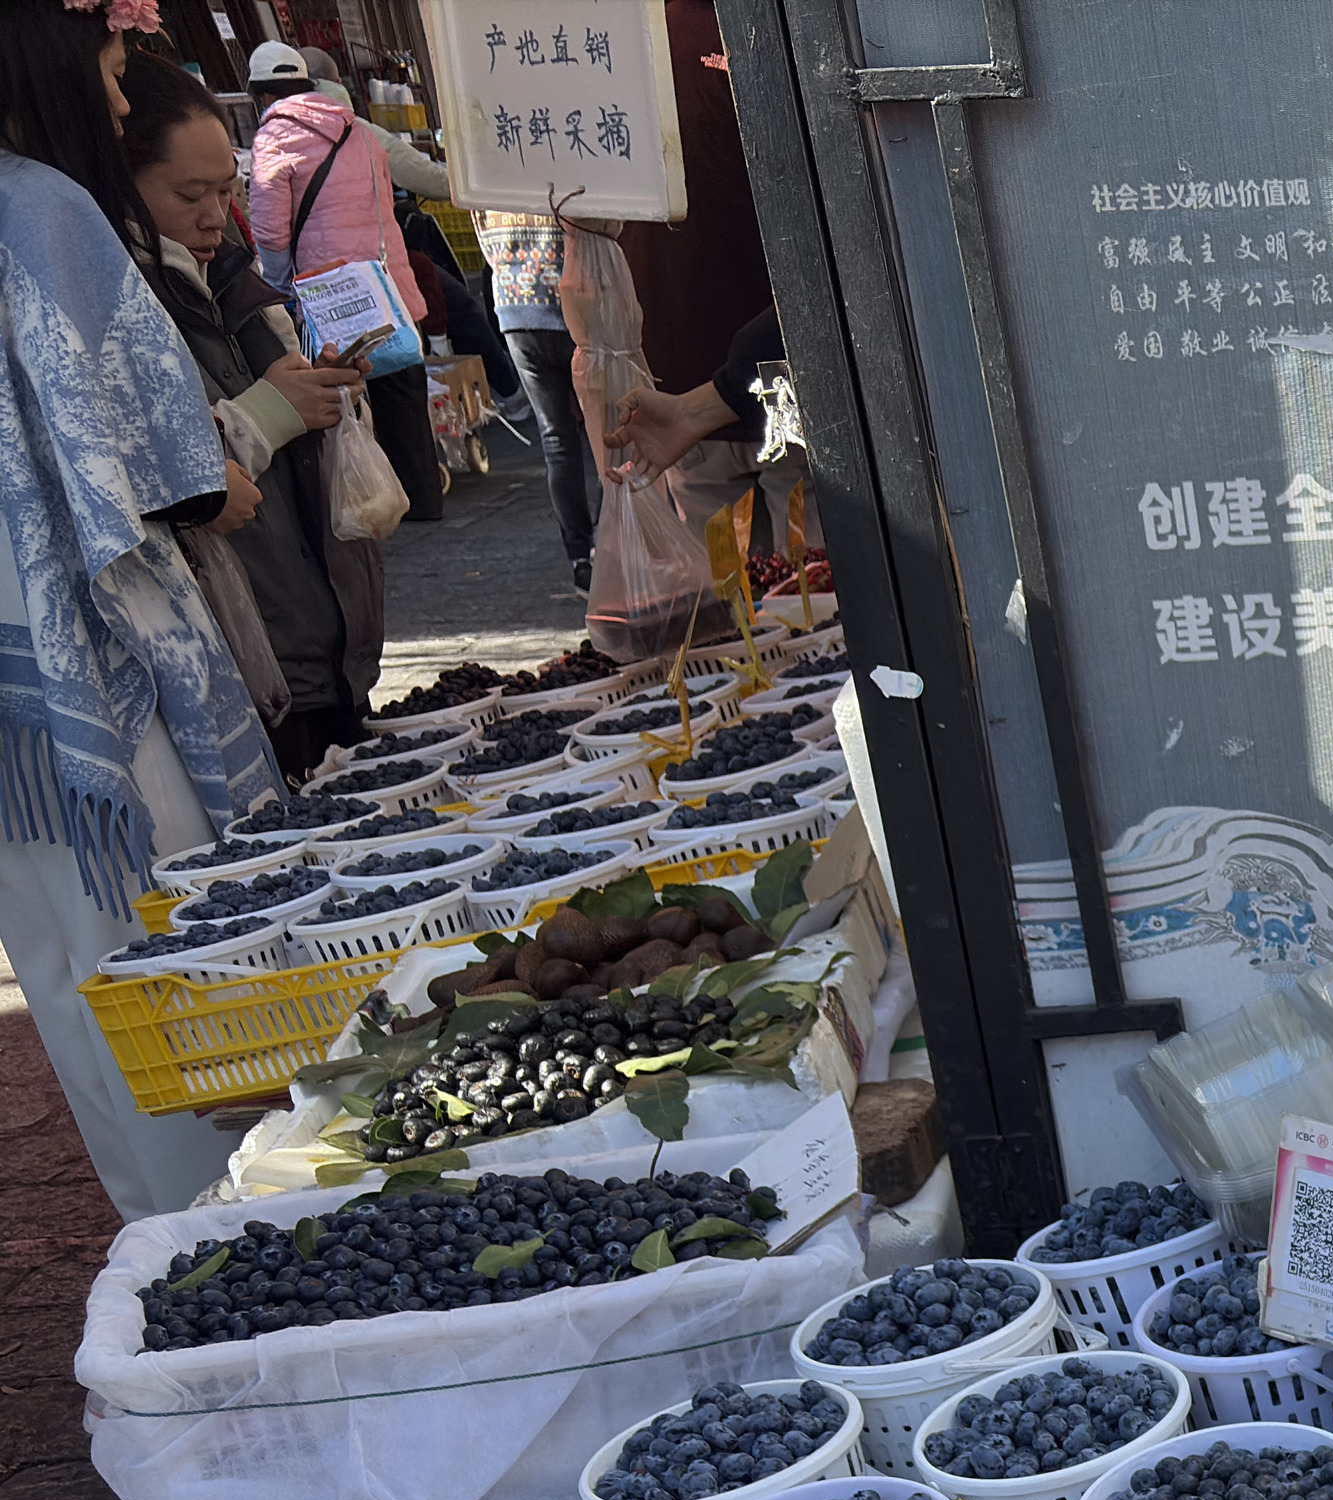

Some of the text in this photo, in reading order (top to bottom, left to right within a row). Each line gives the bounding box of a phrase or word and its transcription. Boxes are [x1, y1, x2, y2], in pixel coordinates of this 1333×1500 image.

[485, 24, 613, 75] 产地直销
[494, 103, 632, 168] 新鲜采摘
[1091, 178, 1311, 213] 社会主义核心价值观
[501, 212, 526, 226] and
[1098, 235, 1151, 269] 富强
[1168, 233, 1217, 266] 民主
[1234, 230, 1289, 262] 文明
[1109, 283, 1157, 314] 自由
[1174, 278, 1227, 313] 平等
[1240, 279, 1295, 307] 公正
[1114, 330, 1163, 362] 爱国
[1181, 328, 1234, 358] 敬业
[1295, 1130, 1315, 1144] ICBC
